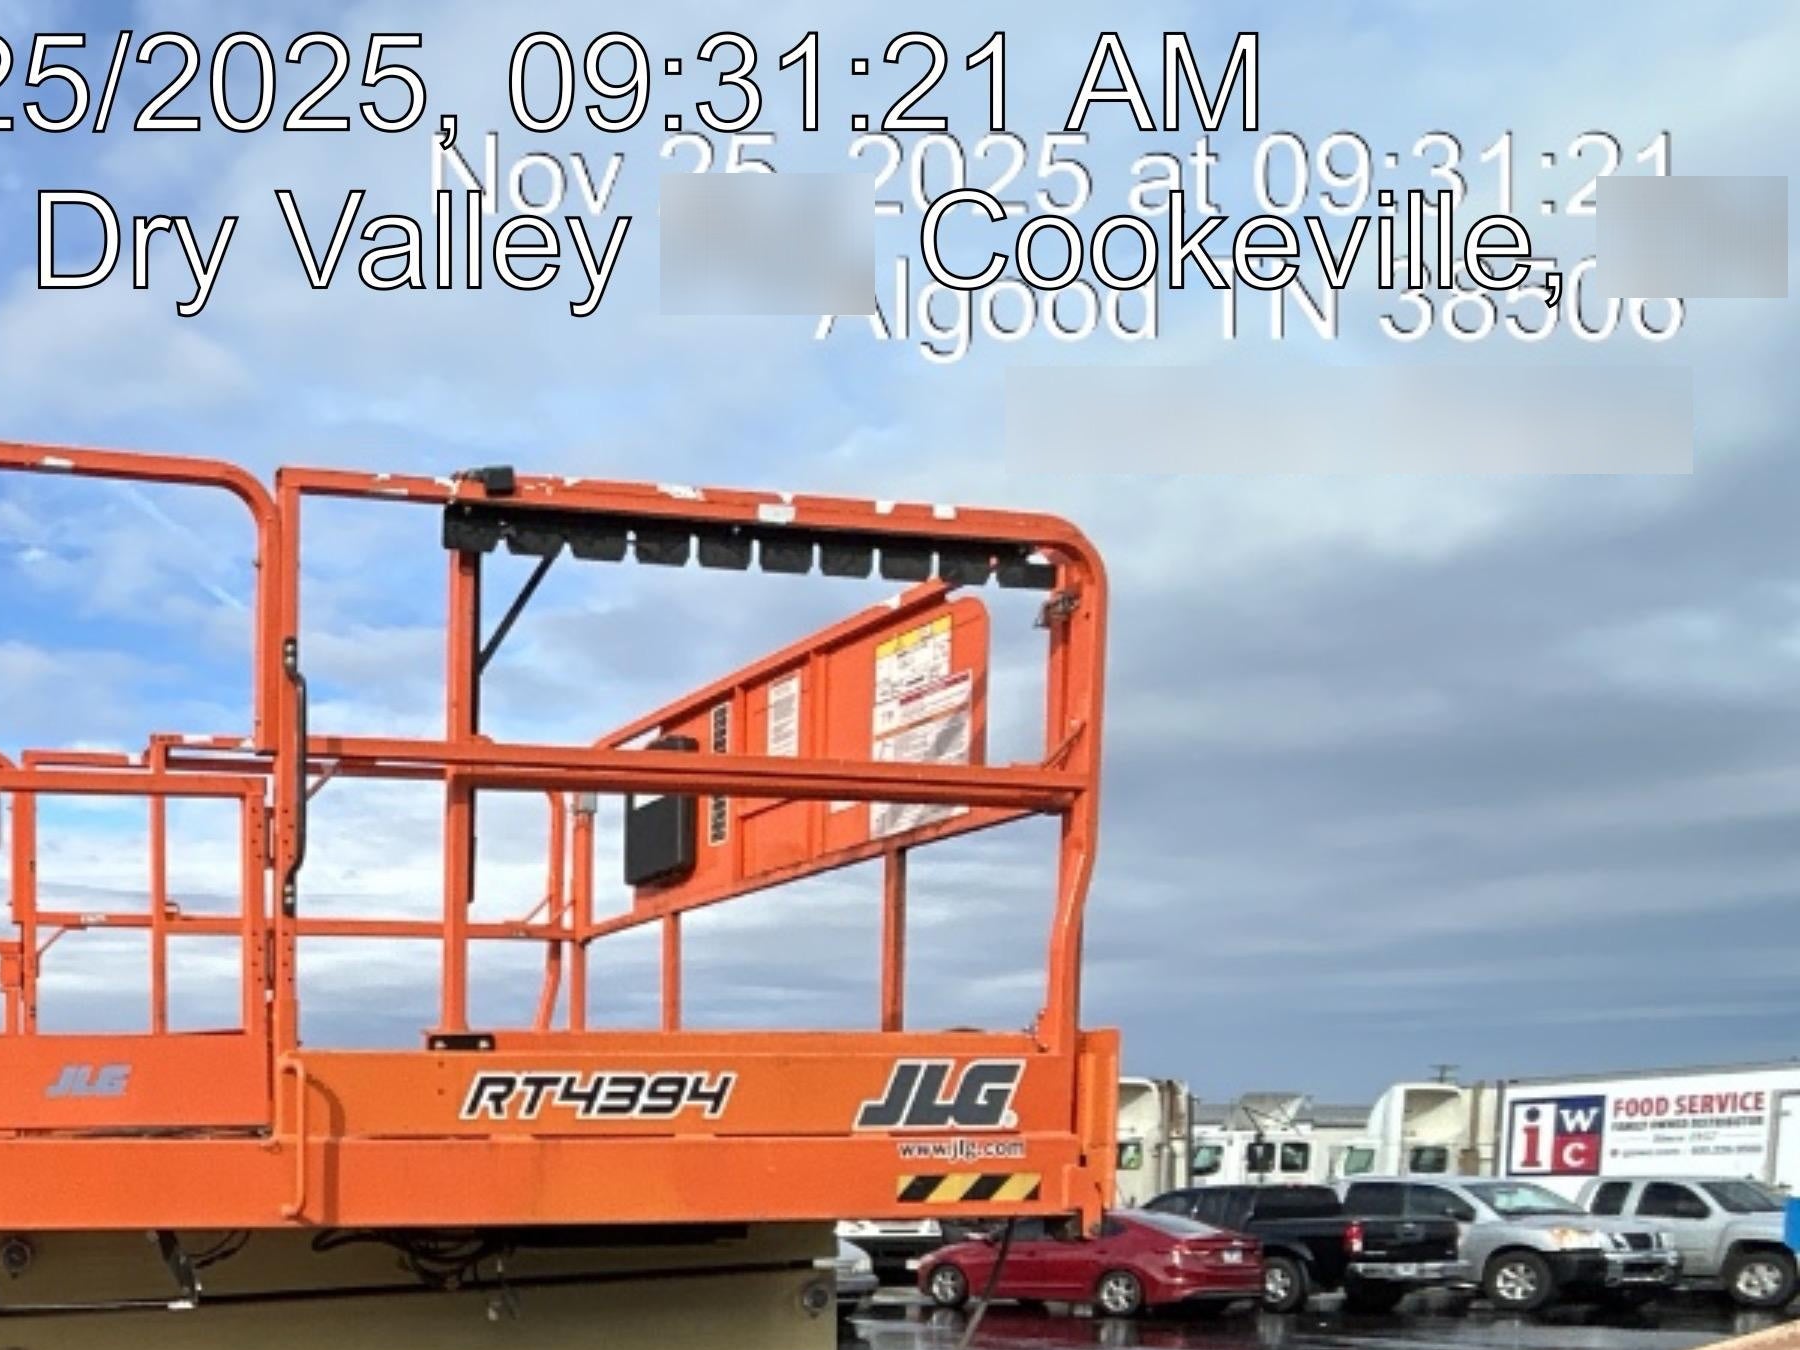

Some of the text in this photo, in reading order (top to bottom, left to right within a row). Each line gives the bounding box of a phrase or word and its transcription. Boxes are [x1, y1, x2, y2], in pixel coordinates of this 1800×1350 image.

[44, 1064, 132, 1097] JLG
[458, 1071, 738, 1120] RT4394
[853, 1059, 1027, 1131] JLG
[1612, 1091, 1766, 1119] FOOD SERVICE
[898, 1138, 1026, 1162] www.jlg.com
